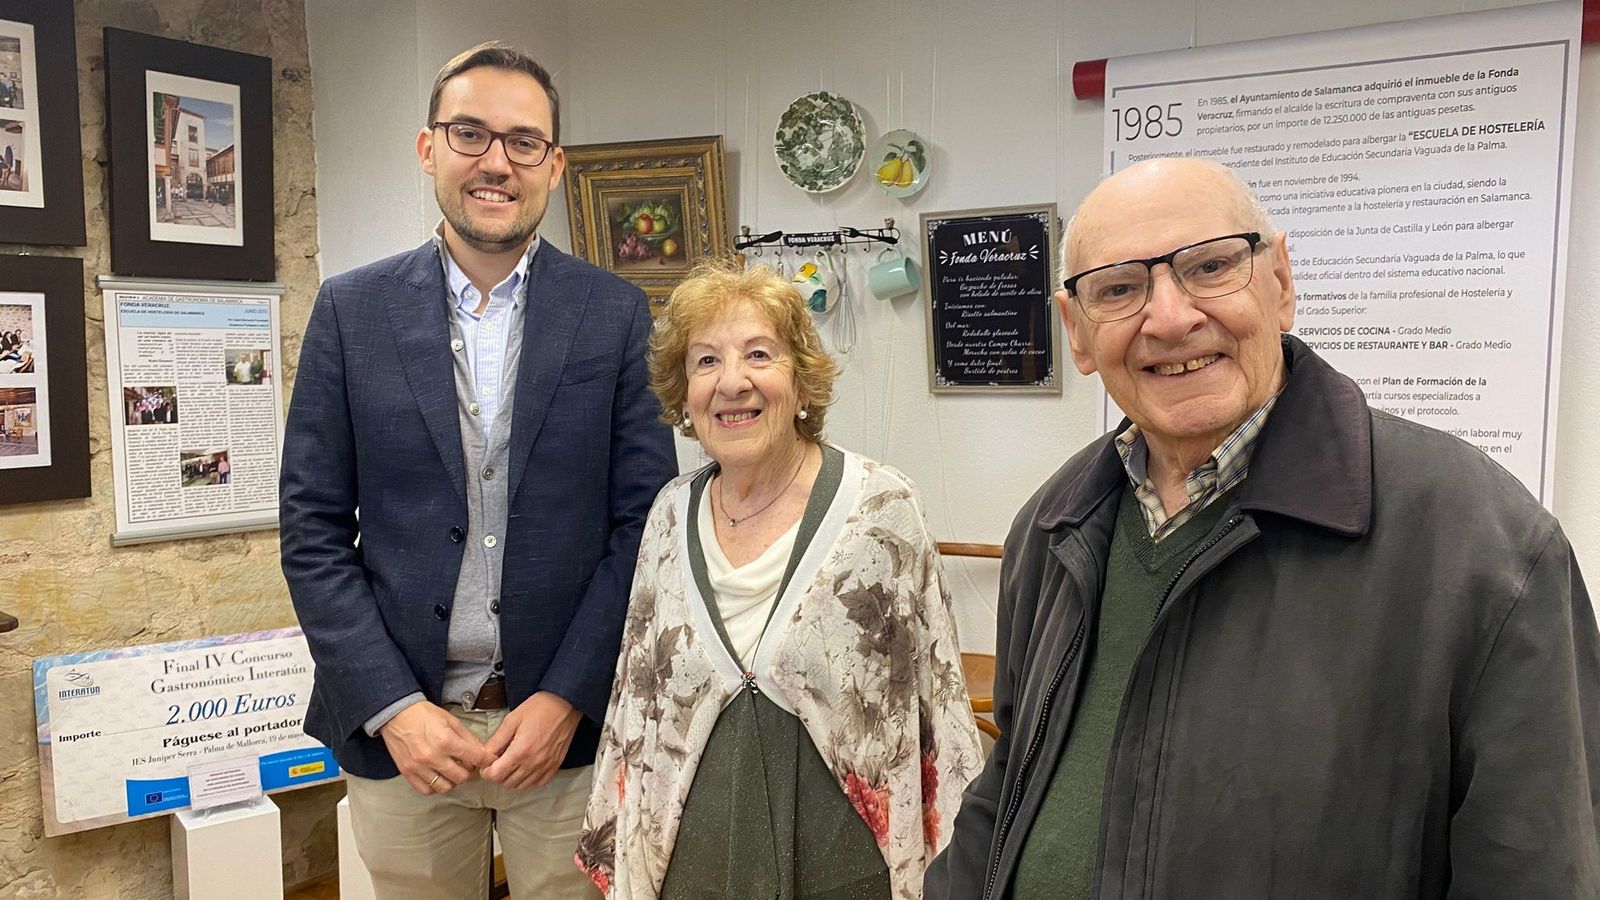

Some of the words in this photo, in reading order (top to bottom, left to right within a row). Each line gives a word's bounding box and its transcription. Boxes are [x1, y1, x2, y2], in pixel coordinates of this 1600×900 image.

[1198, 99, 1208, 107] En
[1209, 97, 1228, 106] 1985,
[1231, 96, 1238, 104] el
[1240, 90, 1300, 104] Ayuntamiento
[1302, 88, 1312, 97] de
[1314, 84, 1362, 96] Salamanca
[1364, 80, 1402, 92] adquirió
[1405, 78, 1413, 86] el
[1416, 74, 1460, 86] inmueble
[1463, 72, 1474, 80] de
[1478, 70, 1486, 79] la
[1488, 68, 1518, 78] Fonda
[1198, 110, 1234, 120] Veracruz,
[1236, 107, 1272, 118] firmando
[1275, 105, 1282, 114] el
[1284, 103, 1313, 113] alcalde
[1316, 102, 1322, 110] la
[1324, 98, 1362, 110] escritura
[1364, 96, 1375, 106] de
[1377, 92, 1436, 104] compraventa
[1438, 90, 1455, 98] con
[1457, 88, 1474, 97] sus
[1476, 84, 1517, 96] antiguos
[1112, 103, 1182, 142] 1985
[1196, 124, 1246, 136] propietarios,
[1248, 122, 1261, 132] por
[1262, 120, 1272, 130] un
[1275, 116, 1308, 128] importe
[1310, 115, 1321, 124] de
[1324, 112, 1366, 124] 12.250.000
[1369, 111, 1380, 120] de
[1382, 110, 1394, 119] las
[1396, 106, 1436, 118] antiguas
[1438, 104, 1476, 116] pesetas.
[1186, 149, 1192, 158] el
[1194, 146, 1228, 156] inmueble
[1230, 145, 1242, 154] fue
[1244, 142, 1285, 153] restaurado
[1293, 138, 1340, 149] remodelado
[1342, 137, 1360, 148] para
[1362, 134, 1397, 146] albergar
[1399, 132, 1406, 141] la
[1462, 126, 1476, 136] DE
[1479, 118, 1545, 134] HOSTELERÍA
[1262, 157, 1273, 166] del
[1276, 154, 1308, 165] Instituto
[1309, 155, 1320, 164] de
[1322, 150, 1364, 162] Educación
[1366, 146, 1412, 159] Secundaria
[1414, 144, 1451, 157] Vaguada
[1454, 142, 1466, 152] de
[1468, 142, 1475, 150] la
[1477, 140, 1508, 150] Palma.
[963, 228, 1012, 246] MENÚ
[950, 252, 978, 266] Fonda
[980, 248, 1026, 264] Veracruz
[1298, 327, 1341, 336] SERVICIOS
[1344, 327, 1356, 336] DE
[1358, 327, 1390, 336] COCINA
[1398, 326, 1423, 335] Grado
[1425, 326, 1452, 334] Medio
[1344, 342, 1356, 350] DE
[1358, 341, 1419, 350] RESTAURANTE
[1421, 341, 1428, 350] Y
[1430, 341, 1448, 350] BAR
[1456, 340, 1482, 350] Grado
[1484, 340, 1512, 350] Medio
[1373, 377, 1380, 386] el
[1382, 377, 1400, 386] Plan
[1403, 377, 1414, 386] de
[1416, 376, 1462, 386] Formación
[1465, 377, 1476, 386] de
[1479, 377, 1486, 386] la
[164, 659, 199, 675] Final
[206, 653, 226, 668] IV
[232, 650, 292, 665] Concurso
[151, 675, 244, 694] Gastronómico
[250, 665, 306, 681] Interatún
[166, 698, 227, 726] 2.000
[232, 693, 296, 716] Euros
[59, 730, 101, 742] Importe
[162, 729, 222, 748] Páguese
[227, 727, 238, 738] al
[244, 718, 303, 738] portador
[132, 758, 146, 766] IES
[178, 749, 198, 757] Serra
[204, 744, 224, 754] Palma
[226, 742, 235, 750] de
[236, 738, 268, 750] Mallorca,
[269, 735, 277, 743] 19
[278, 734, 287, 742] de
